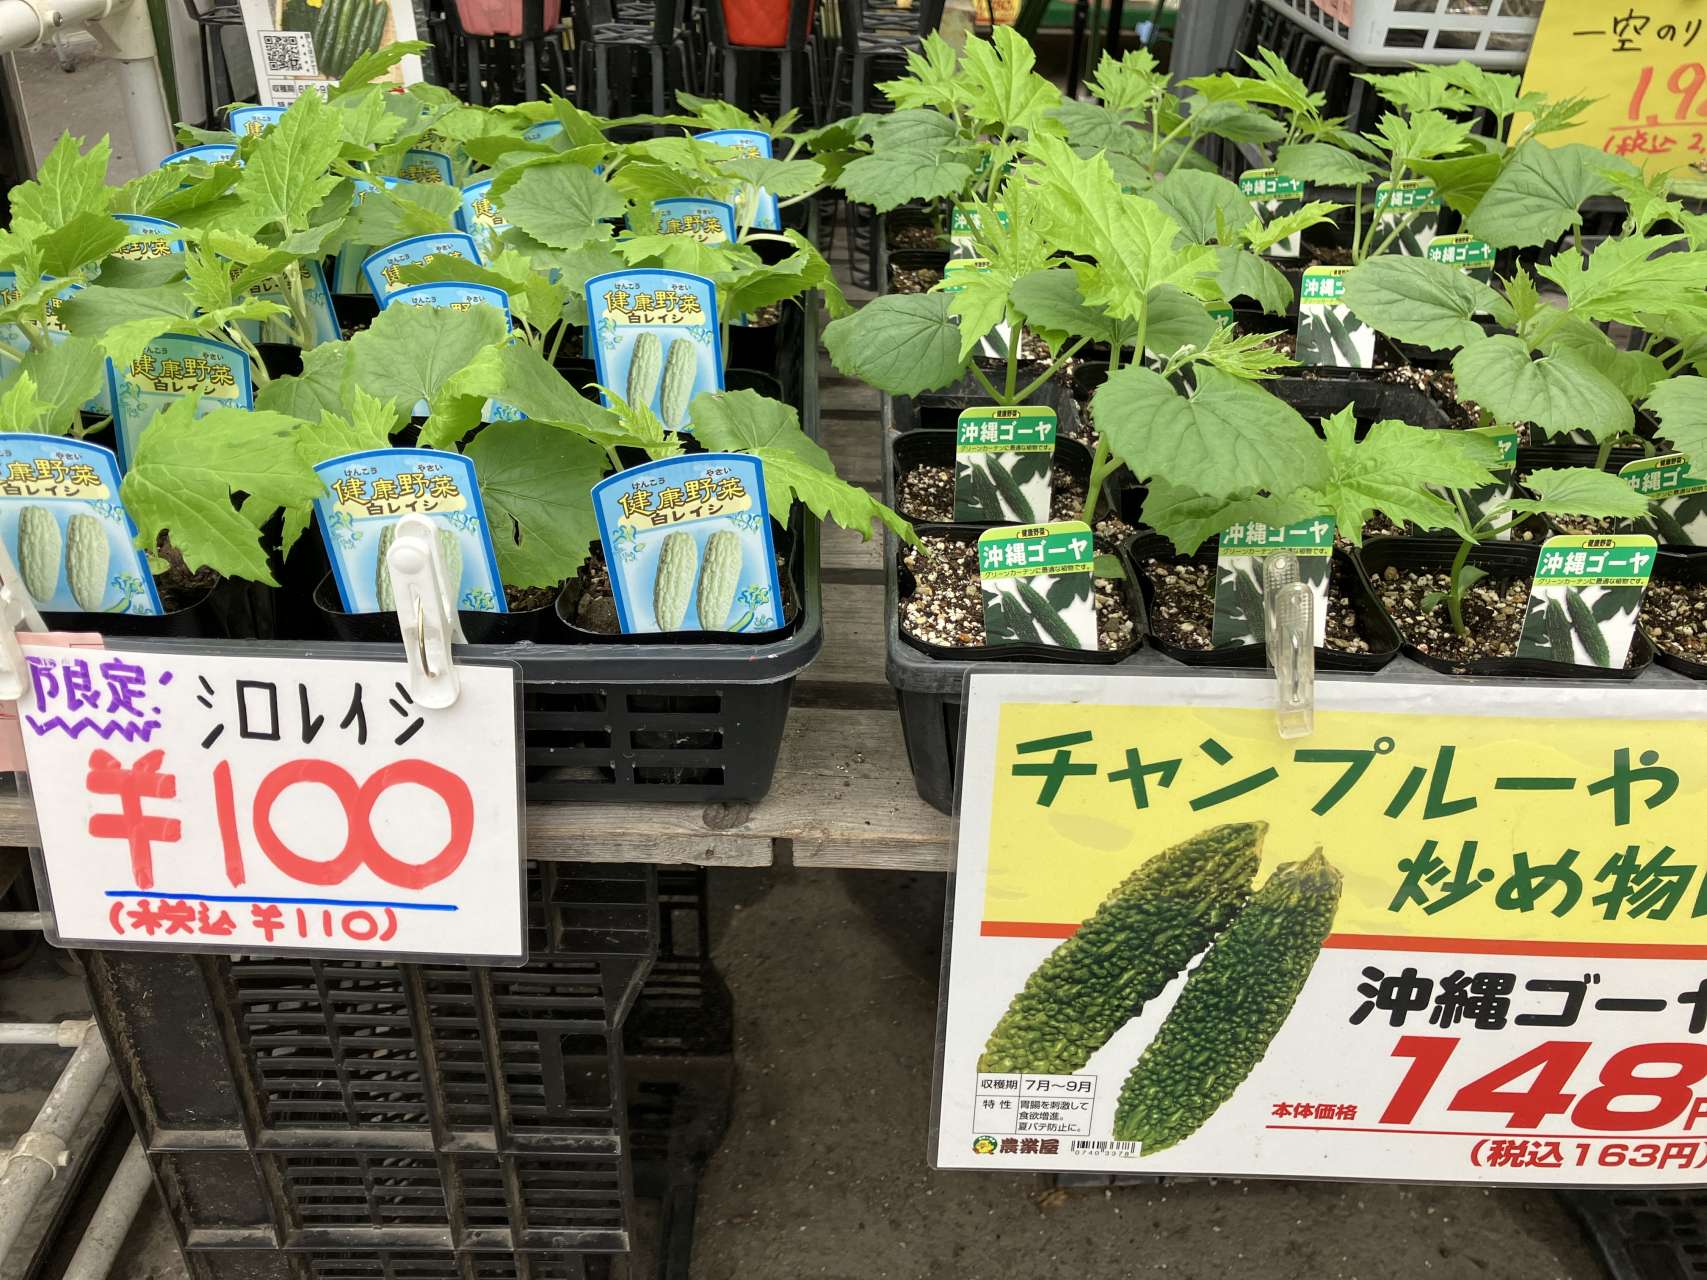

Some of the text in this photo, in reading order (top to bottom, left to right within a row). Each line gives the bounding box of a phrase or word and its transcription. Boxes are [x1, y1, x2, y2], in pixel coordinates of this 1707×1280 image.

[657, 215, 722, 235] 康野菜
[615, 282, 641, 290] けんこう
[412, 296, 437, 304] けんこう
[466, 295, 486, 303] やさい
[603, 289, 702, 315] 健康野菜
[627, 312, 684, 324] 白レイシ
[130, 353, 235, 385] 健康野菜
[960, 421, 1053, 443] 沖縄ゴーヤ
[55, 451, 82, 461] やさい
[0, 458, 102, 486] 康野菜
[343, 467, 378, 477] けんこう
[417, 463, 444, 472] やさい
[706, 466, 733, 477] やさい
[2, 483, 80, 497] 白レイシ
[331, 472, 460, 506] 健康野菜
[631, 476, 666, 490] けんこう
[617, 476, 746, 519] 健康野菜
[365, 500, 439, 516] 白レイシ
[650, 504, 724, 526] 白レイシ
[1222, 520, 1329, 545] 沖縄ゴーヤ
[983, 538, 1088, 568] 沖縄ゴーヤ
[1540, 551, 1650, 575] 沖縄ゴーヤ
[196, 674, 425, 749] シロレイシ
[1012, 731, 1680, 827] チャンプルーや
[85, 748, 475, 891] ¥100
[981, 1079, 1018, 1090] 収穫期
[1020, 1100, 1089, 1111] 胃腸を刺激して
[1271, 1102, 1358, 1122] 本体価格
[1018, 1111, 1063, 1121] 食欲増進。
[1018, 1121, 1081, 1133] 夏バテ防止に。
[1000, 1137, 1060, 1155] 農業屋
